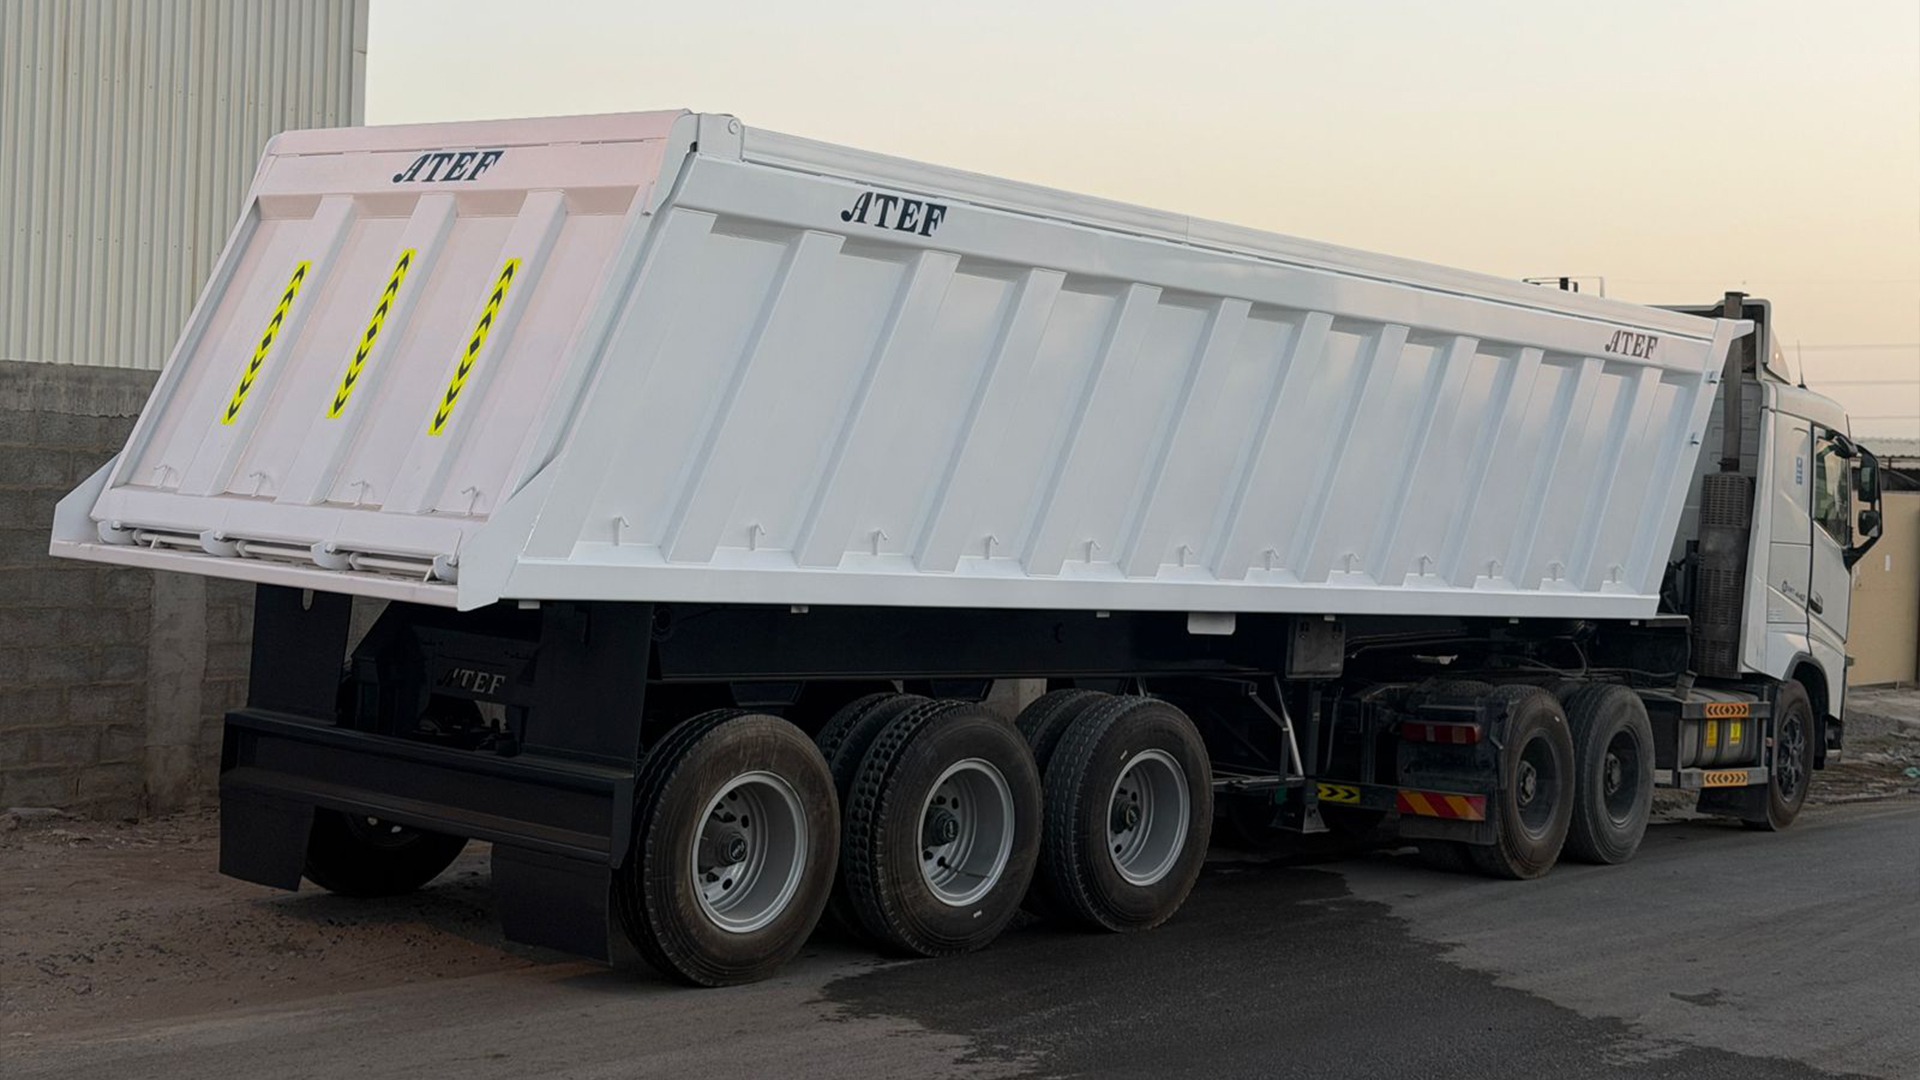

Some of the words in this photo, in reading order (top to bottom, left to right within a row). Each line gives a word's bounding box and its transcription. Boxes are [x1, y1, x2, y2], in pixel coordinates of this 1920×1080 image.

[392, 150, 504, 183] ATEF
[840, 191, 948, 237] ATEF
[1604, 329, 1659, 360] ATEF
[436, 667, 507, 695] ATEF
